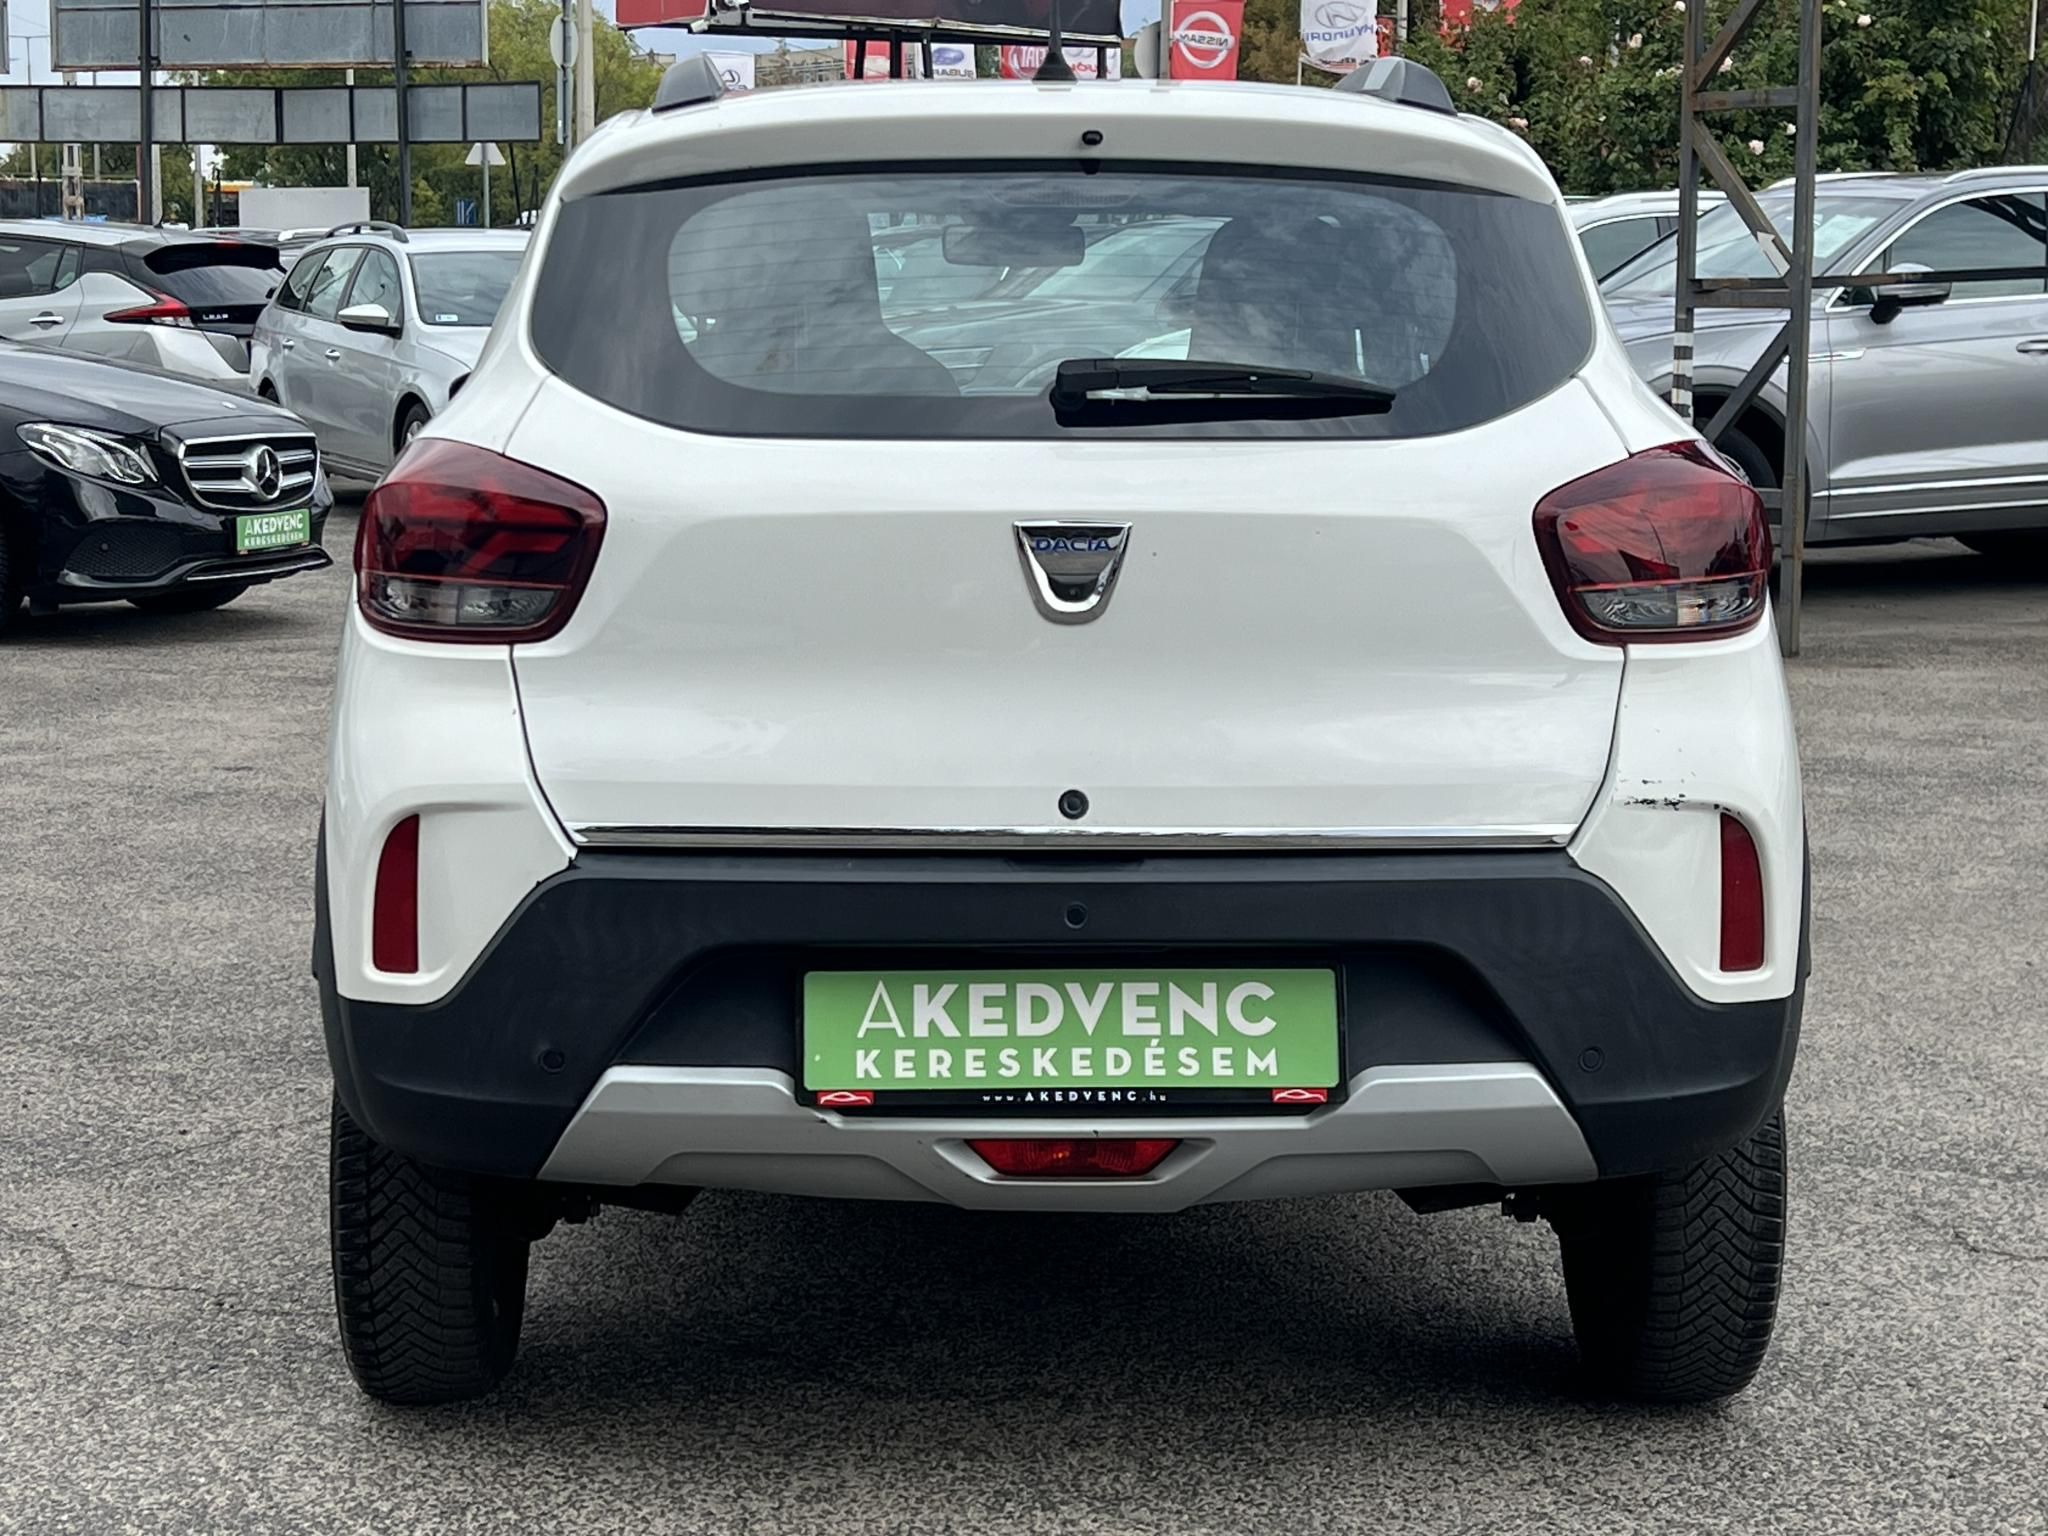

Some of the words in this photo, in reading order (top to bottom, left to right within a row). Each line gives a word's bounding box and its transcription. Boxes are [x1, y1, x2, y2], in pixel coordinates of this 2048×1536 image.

[244, 513, 304, 536] AKEDVENC
[1034, 537, 1112, 552] DACIA
[856, 980, 1278, 1039] AKEDVENC
[855, 1037, 1279, 1080] KERESKEDÉSEM
[982, 1090, 1167, 1102] www.AKEDVENC.hu
